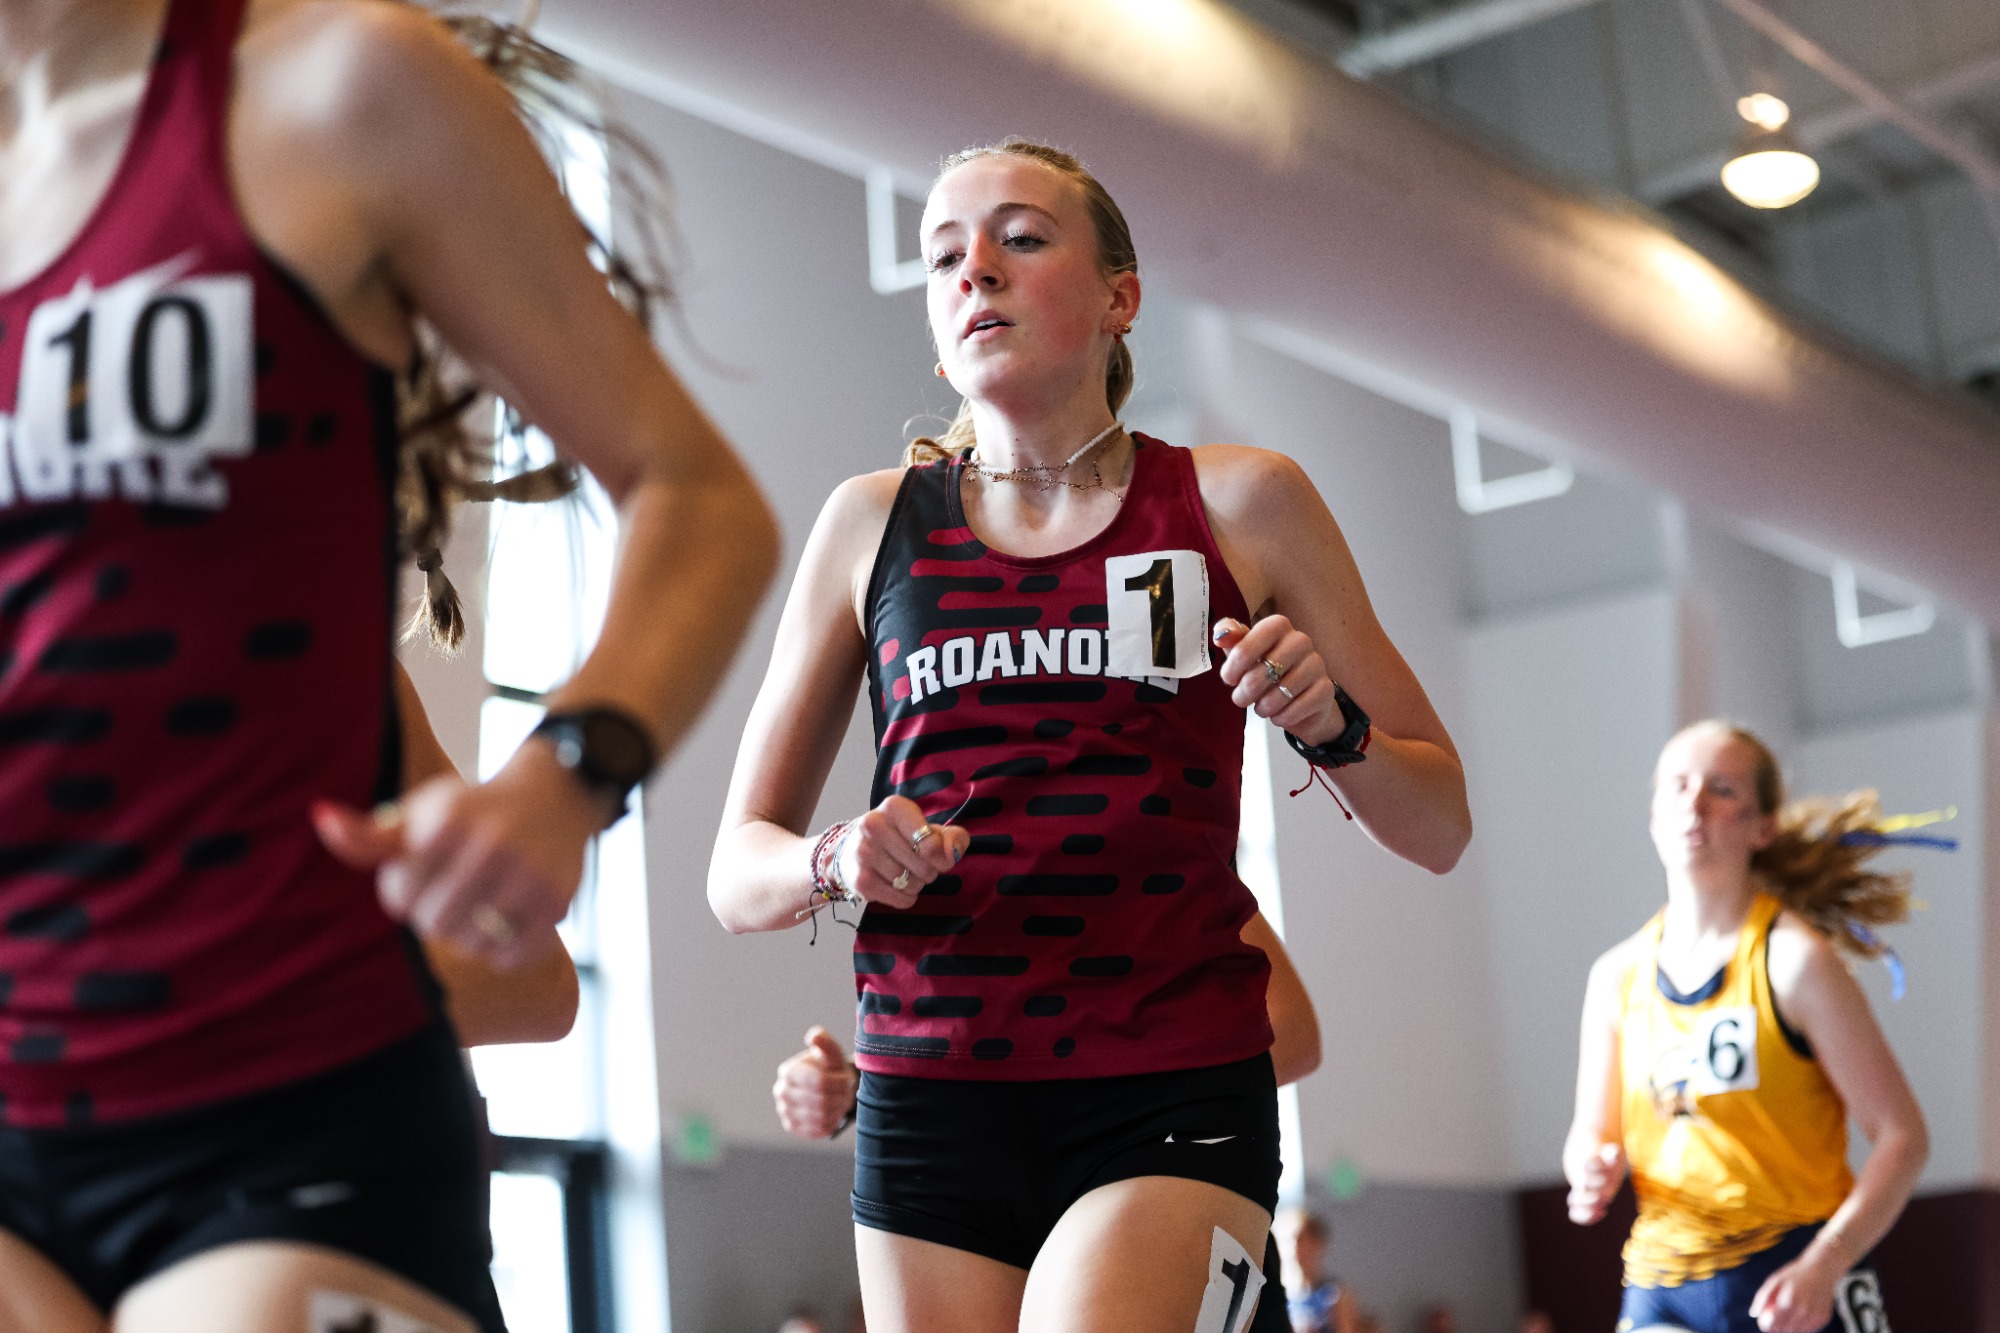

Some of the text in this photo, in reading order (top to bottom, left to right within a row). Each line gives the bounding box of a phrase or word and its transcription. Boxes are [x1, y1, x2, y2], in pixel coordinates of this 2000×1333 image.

[47, 295, 215, 447] 10
[1124, 558, 1176, 670] 1
[906, 628, 1179, 706] ROANO
[1708, 1018, 1746, 1082] 6
[1221, 1257, 1250, 1333] 1
